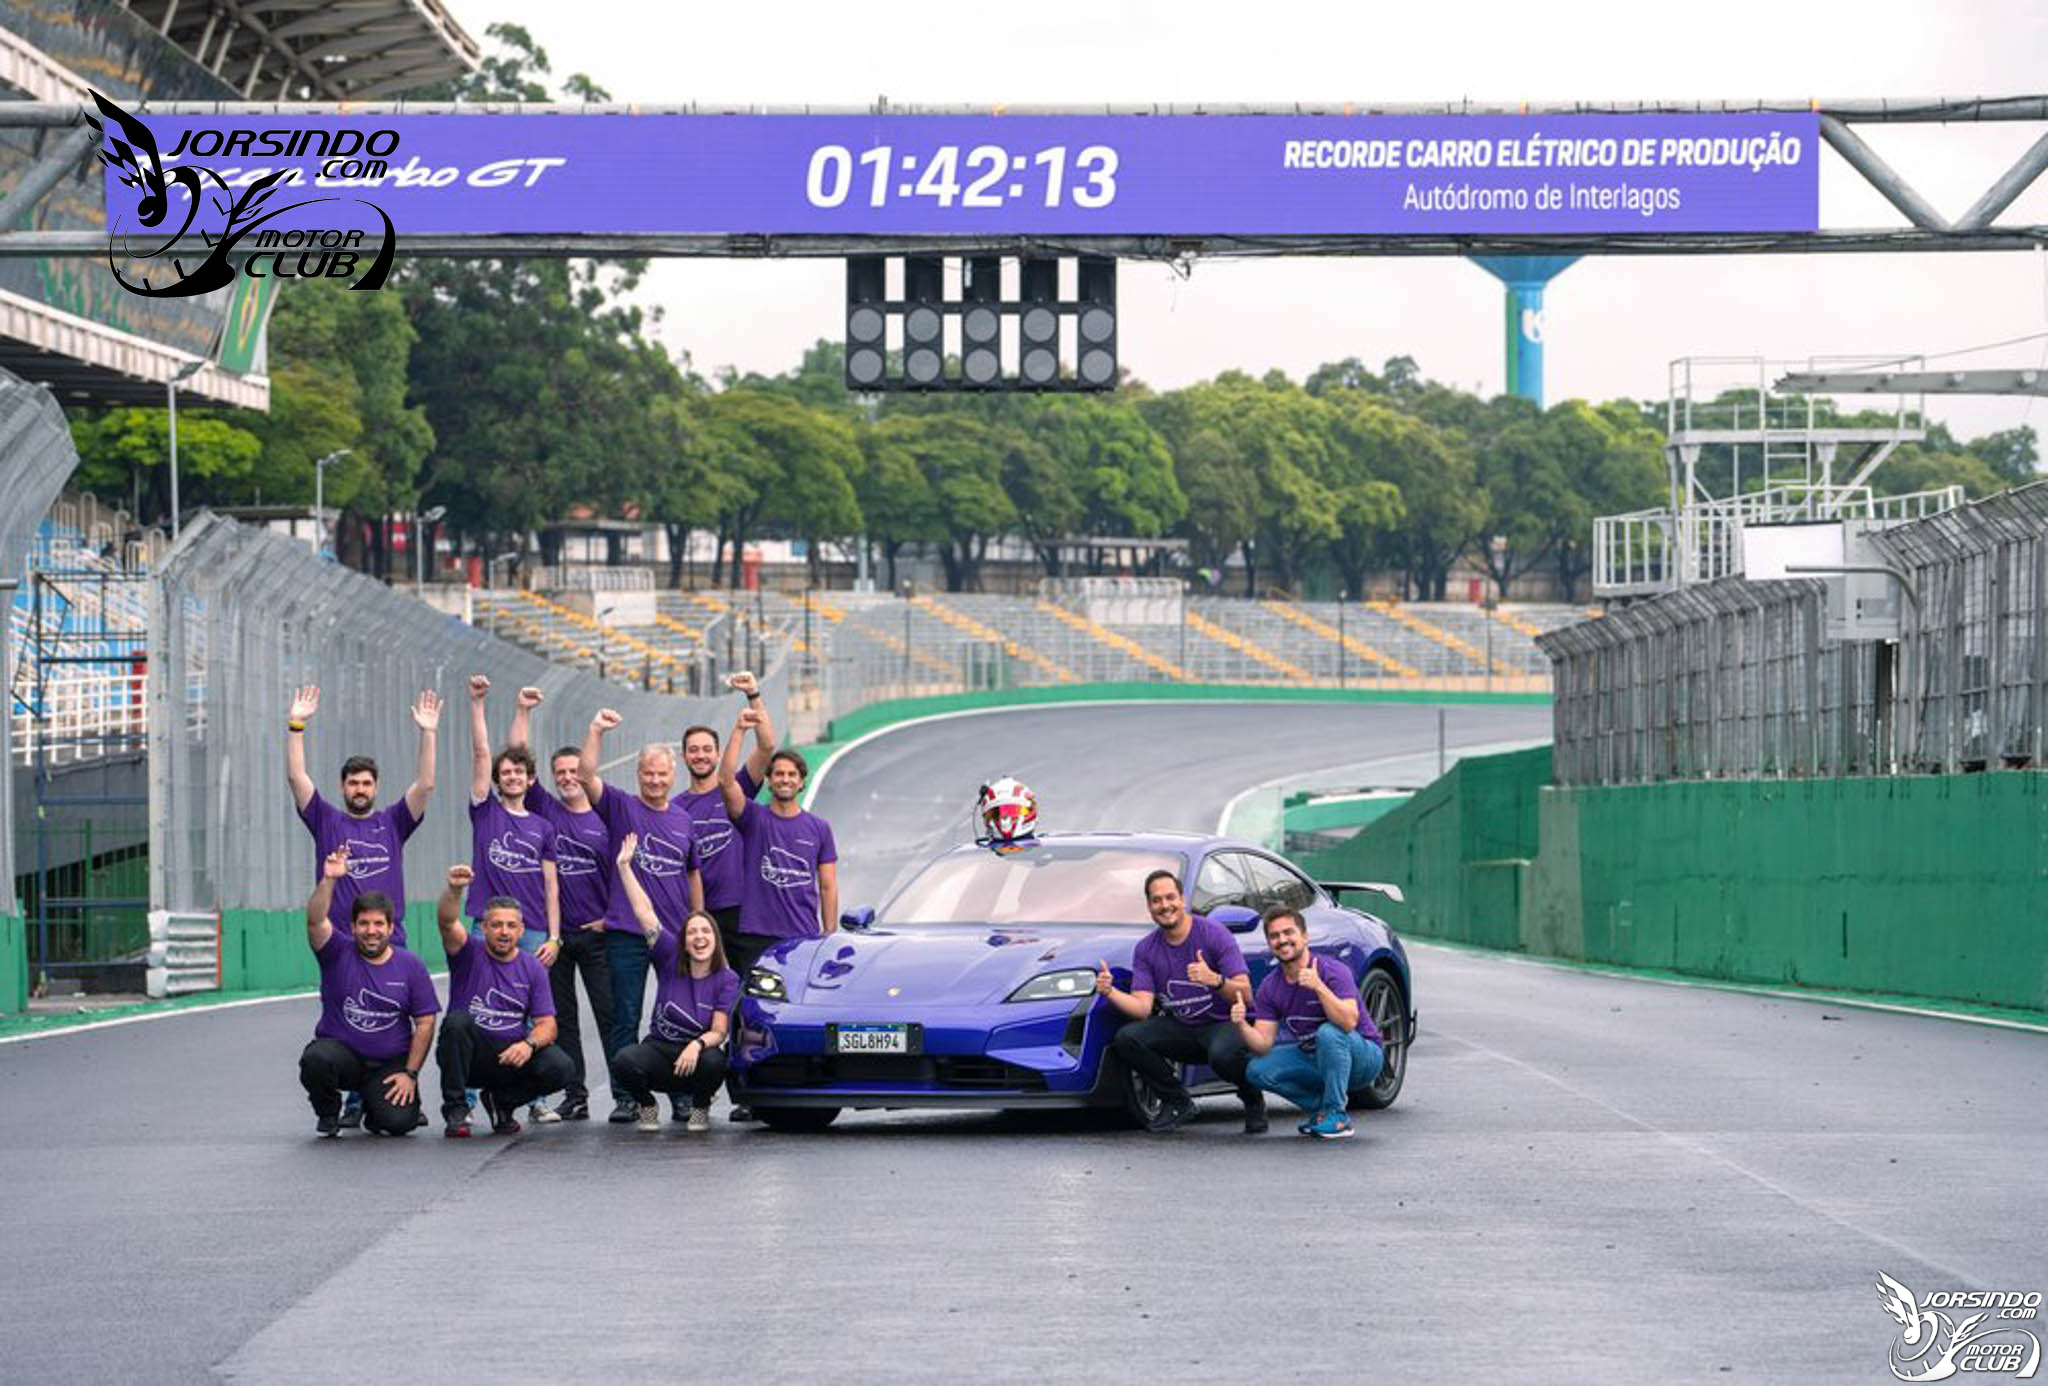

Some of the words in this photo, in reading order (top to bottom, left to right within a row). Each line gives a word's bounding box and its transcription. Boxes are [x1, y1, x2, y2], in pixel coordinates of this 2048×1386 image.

[1283, 139, 1403, 169] RECORDE
[1405, 138, 1493, 169] CARRO
[1495, 131, 1618, 167] ELÉTRICO
[1621, 138, 1658, 167] DE
[1659, 130, 1802, 173] PRODUÇÃO
[466, 157, 567, 188] GT
[806, 144, 1119, 208] 01:42:13
[1403, 183, 1529, 211] Autódromo
[1534, 183, 1563, 210] de
[1570, 182, 1681, 217] Interlagos
[843, 1033, 899, 1049] SGL8H94
